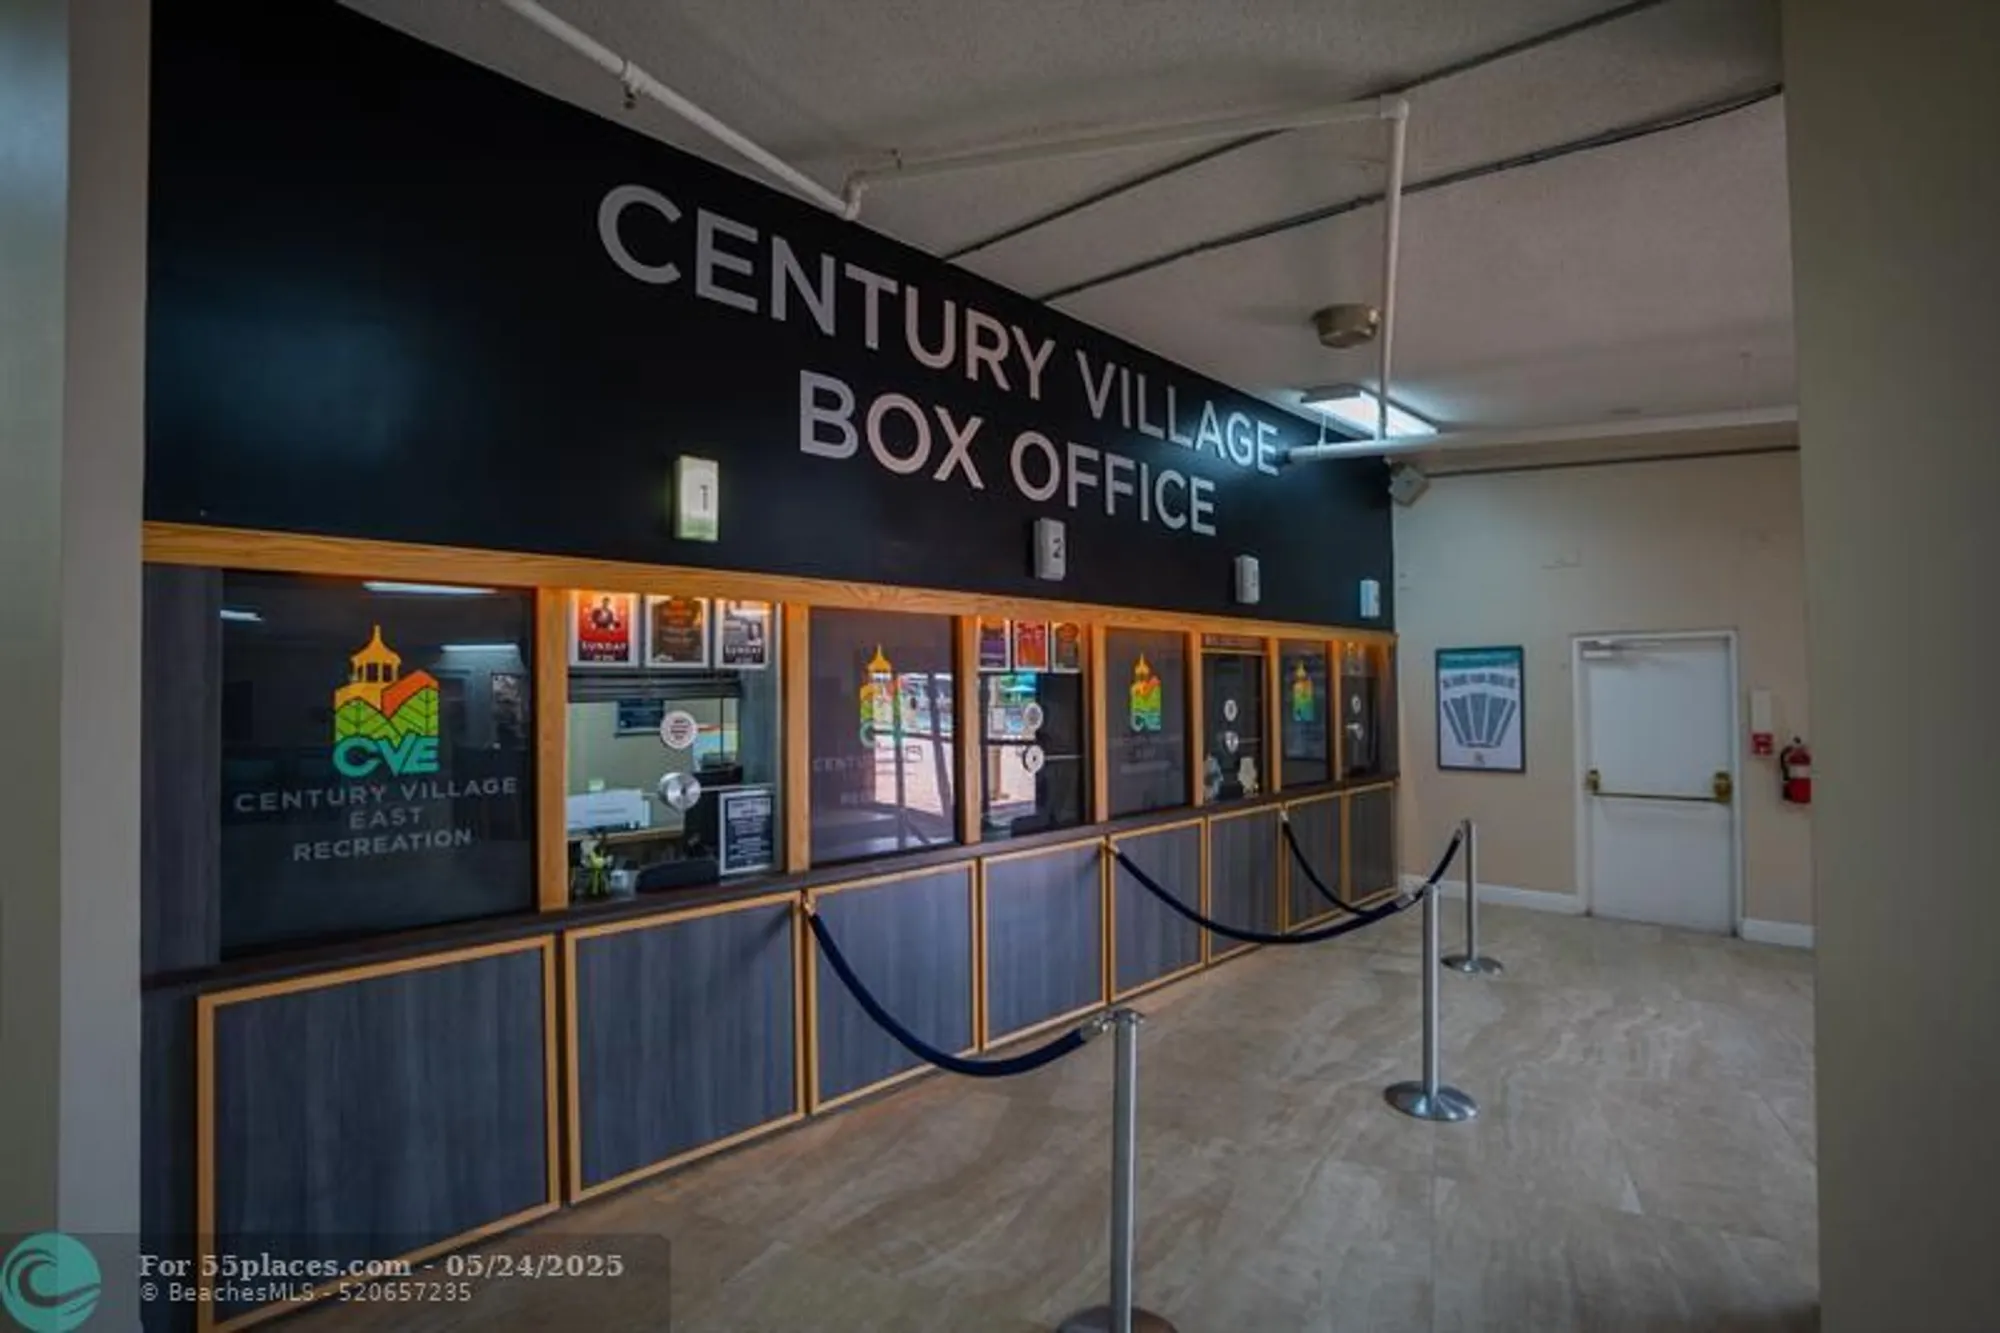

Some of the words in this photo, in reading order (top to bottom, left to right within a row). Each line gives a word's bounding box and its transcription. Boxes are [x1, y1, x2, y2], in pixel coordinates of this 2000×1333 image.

[598, 184, 1055, 400] CENTURY
[1077, 349, 1281, 476] VILLAGE
[799, 370, 984, 490] BOX
[1010, 430, 1218, 536] OFFICE
[1052, 537, 1064, 559] 2
[582, 641, 627, 652] SUNDAY
[332, 736, 440, 776] CVE
[235, 784, 387, 812] CENTURY
[400, 777, 517, 801] VILLAGE
[350, 807, 422, 830] EAST
[293, 828, 471, 862] RECREATION
